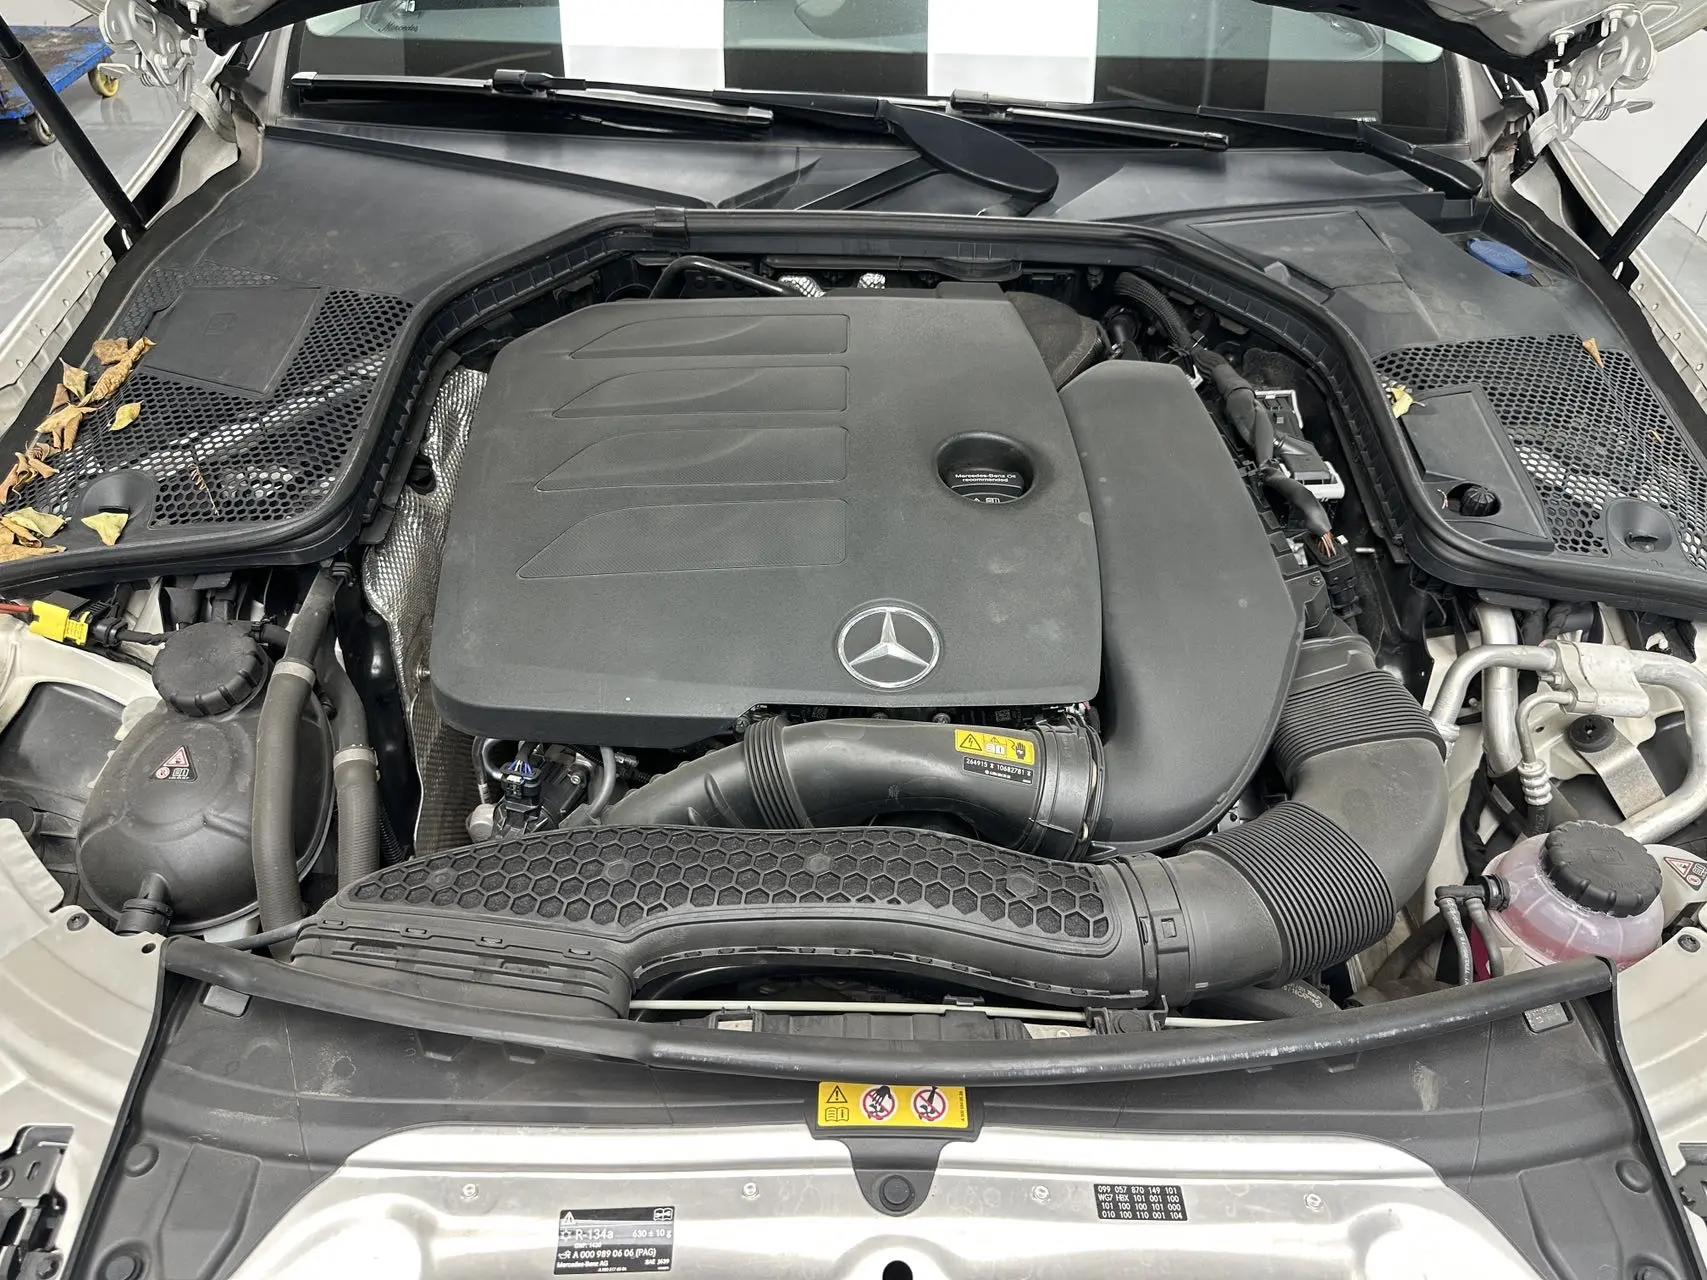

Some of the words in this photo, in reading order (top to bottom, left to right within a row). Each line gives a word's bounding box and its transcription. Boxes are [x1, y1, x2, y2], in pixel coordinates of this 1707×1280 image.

[1097, 1185, 1111, 1193] 099
[1131, 1186, 1145, 1194] 870
[1148, 1186, 1161, 1194] 149
[1097, 1193, 1114, 1201] WG7
[1115, 1194, 1130, 1202] HBX
[1133, 1194, 1146, 1202] 101
[1166, 1195, 1180, 1203] 100
[1101, 1202, 1114, 1210] 101
[1135, 1203, 1148, 1211] 100
[1151, 1203, 1164, 1211] 101
[1167, 1203, 1181, 1211] 000
[1101, 1210, 1116, 1218] 010
[1119, 1211, 1133, 1219] 100
[1136, 1211, 1150, 1219] 110
[1152, 1211, 1166, 1219] 001
[575, 1228, 614, 1240] R-134a
[632, 1229, 647, 1238] 630
[656, 1228, 665, 1237] 10
[572, 1251, 579, 1259] A
[580, 1251, 595, 1259] 000
[596, 1250, 611, 1258] 989
[612, 1249, 622, 1258] 06
[624, 1249, 634, 1257] 06
[635, 1248, 657, 1258] (PAG)
